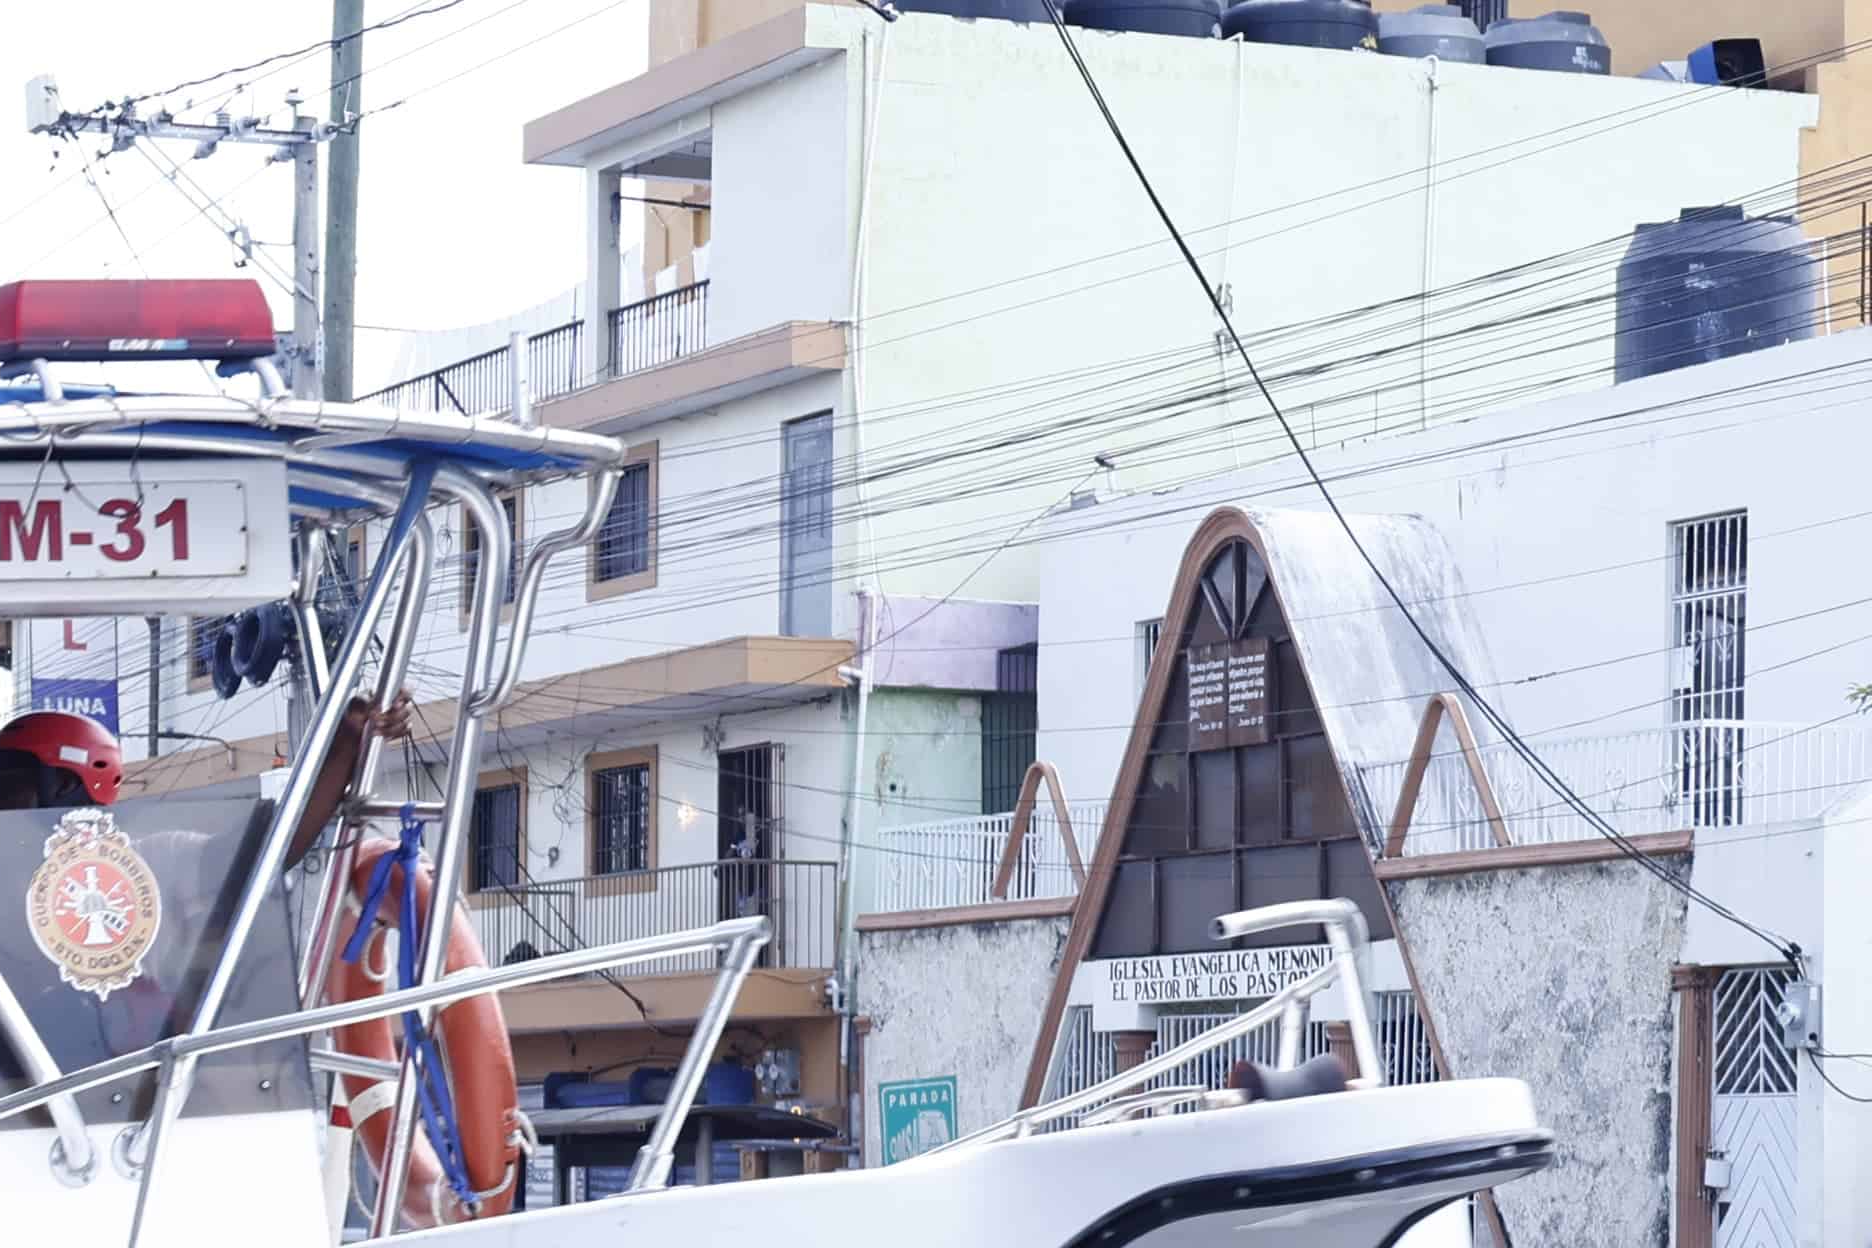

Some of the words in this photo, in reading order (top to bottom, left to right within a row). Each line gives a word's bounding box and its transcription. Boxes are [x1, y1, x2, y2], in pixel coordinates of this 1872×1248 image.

[43, 697, 107, 716] LUNA
[58, 845, 80, 865] DE
[98, 843, 153, 919] BOMBEROS
[1109, 958, 1164, 981] IGLESIA
[1172, 952, 1261, 977] EVANGELICA
[1267, 946, 1334, 972] MENONIT
[1112, 981, 1129, 1001] EL
[1134, 978, 1181, 1001] PASTOR
[1186, 979, 1202, 998] DE
[1209, 977, 1238, 997] LOS
[888, 1088, 949, 1108] PARADA
